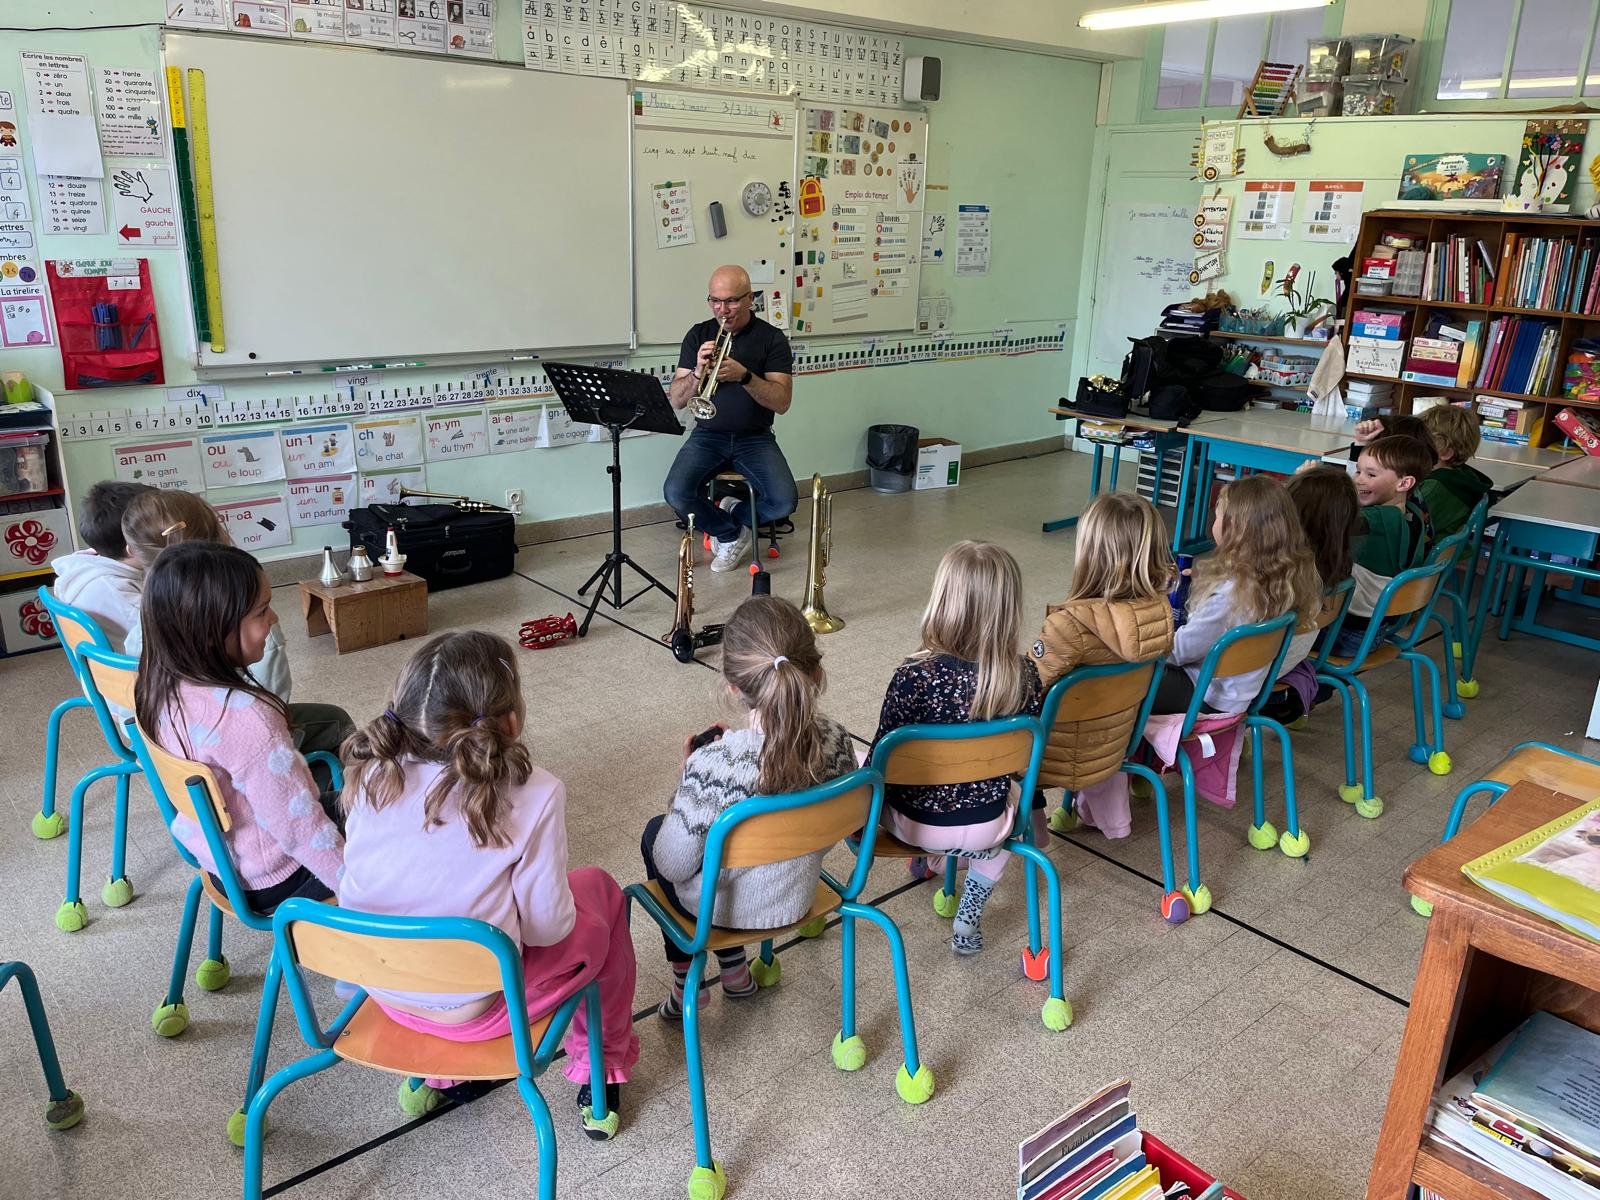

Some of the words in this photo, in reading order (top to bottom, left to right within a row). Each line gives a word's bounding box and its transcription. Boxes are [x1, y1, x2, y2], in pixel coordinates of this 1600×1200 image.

[726, 16, 733, 26] M
[740, 18, 747, 28] N
[754, 20, 762, 30] O
[546, 29, 553, 42] b
[582, 36, 589, 46] d
[8, 176, 13, 186] 4
[845, 190, 863, 200] Emploi
[873, 192, 889, 200] temps
[145, 219, 173, 228] gauche
[673, 224, 682, 232] ed
[152, 231, 175, 244] gauche
[476, 368, 497, 380] trente
[348, 376, 368, 385] vingt
[187, 389, 201, 397] dix
[136, 421, 142, 429] 6
[169, 418, 176, 426] 8
[186, 417, 191, 425] 9
[298, 408, 308, 416] 16
[326, 405, 337, 413] 18
[340, 404, 350, 412] 19
[370, 402, 380, 410] 21
[409, 398, 419, 406] 24
[359, 429, 374, 440] ch
[566, 429, 593, 439] cigogne
[520, 435, 542, 444] baleine
[207, 445, 225, 456] ou
[358, 442, 374, 457] ch
[441, 444, 452, 453] du
[454, 442, 474, 452] thym
[375, 454, 384, 462] le
[385, 452, 403, 461] chat
[304, 462, 315, 470] un
[318, 460, 335, 469] ami
[158, 467, 178, 478] gant
[227, 470, 237, 478] le
[239, 468, 261, 477] loup
[159, 480, 188, 488] lampe
[364, 478, 374, 488] in
[300, 511, 311, 519] un
[314, 507, 346, 518] parfum
[244, 534, 262, 544] noir
